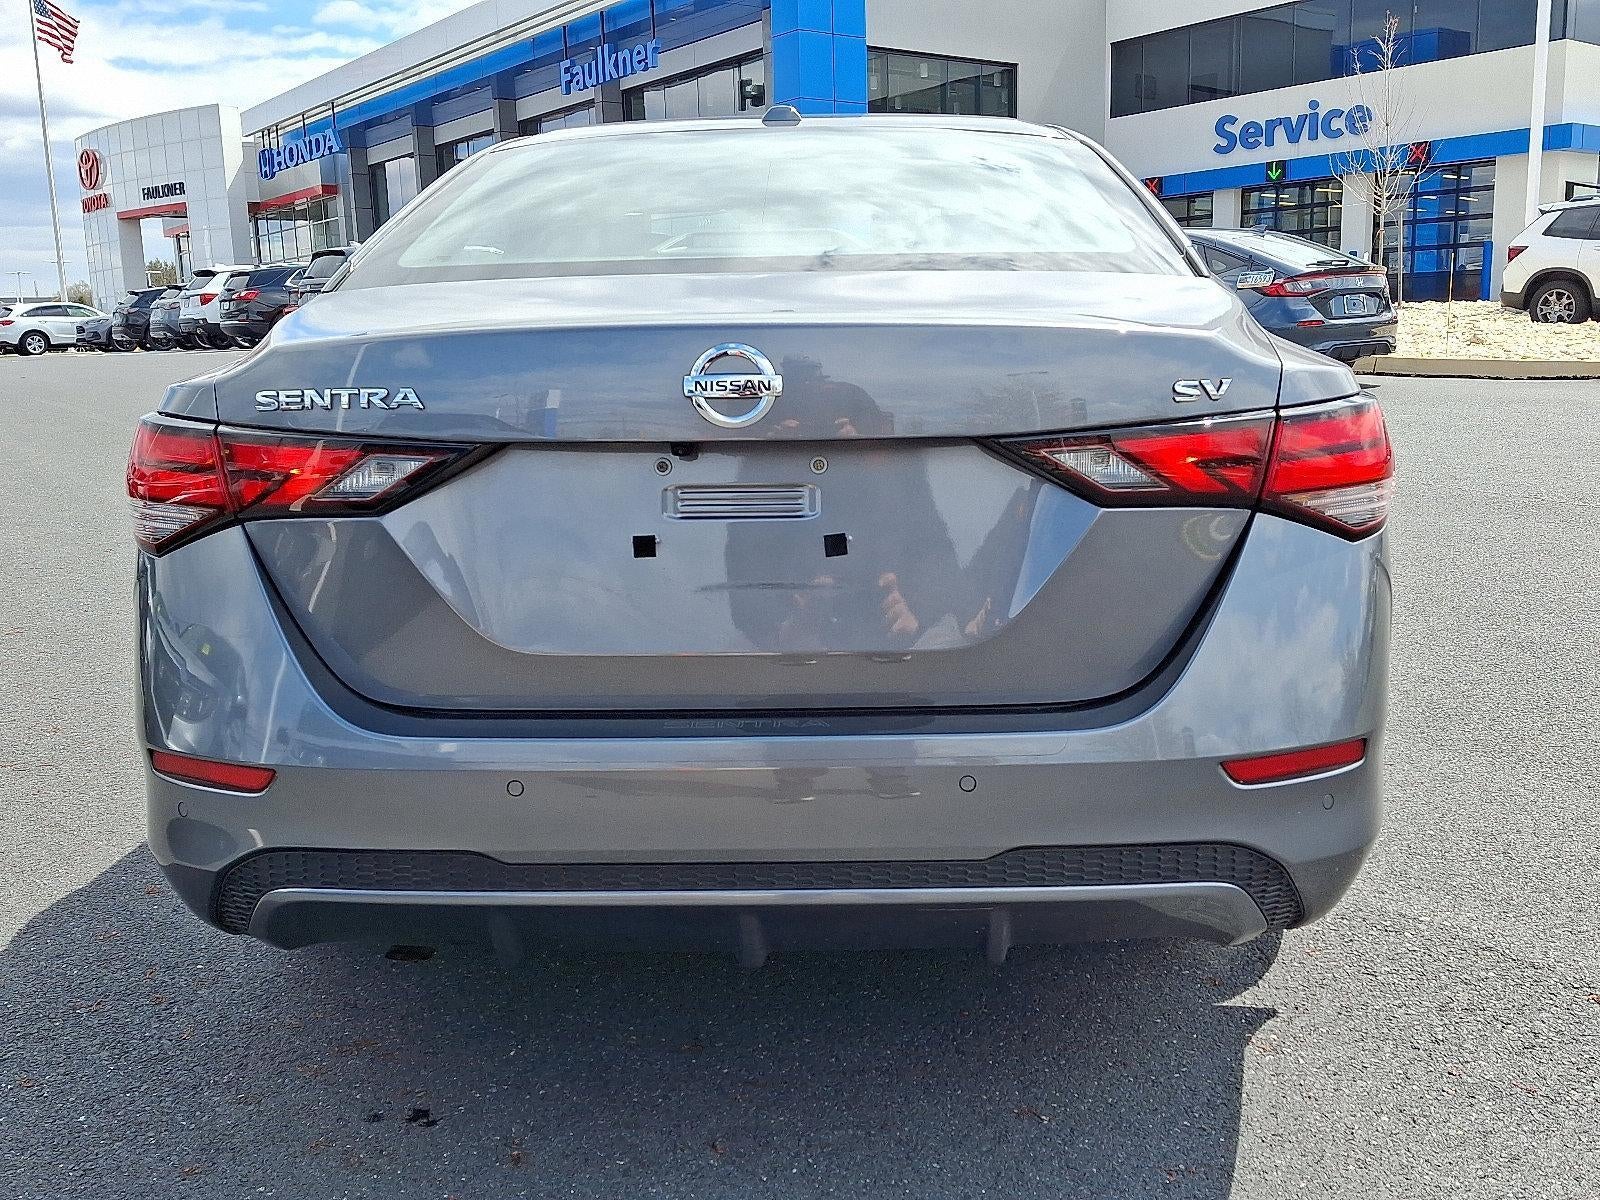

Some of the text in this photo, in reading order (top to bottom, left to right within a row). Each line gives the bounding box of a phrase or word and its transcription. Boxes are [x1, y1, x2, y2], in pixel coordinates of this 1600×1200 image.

[560, 38, 660, 96] Faulkner
[1212, 99, 1373, 155] Service
[272, 128, 342, 173] HONDA
[141, 181, 186, 201] FAULKNER
[254, 387, 426, 412] SENTRA
[694, 379, 772, 393] NISSAN
[1172, 377, 1233, 404] SV
